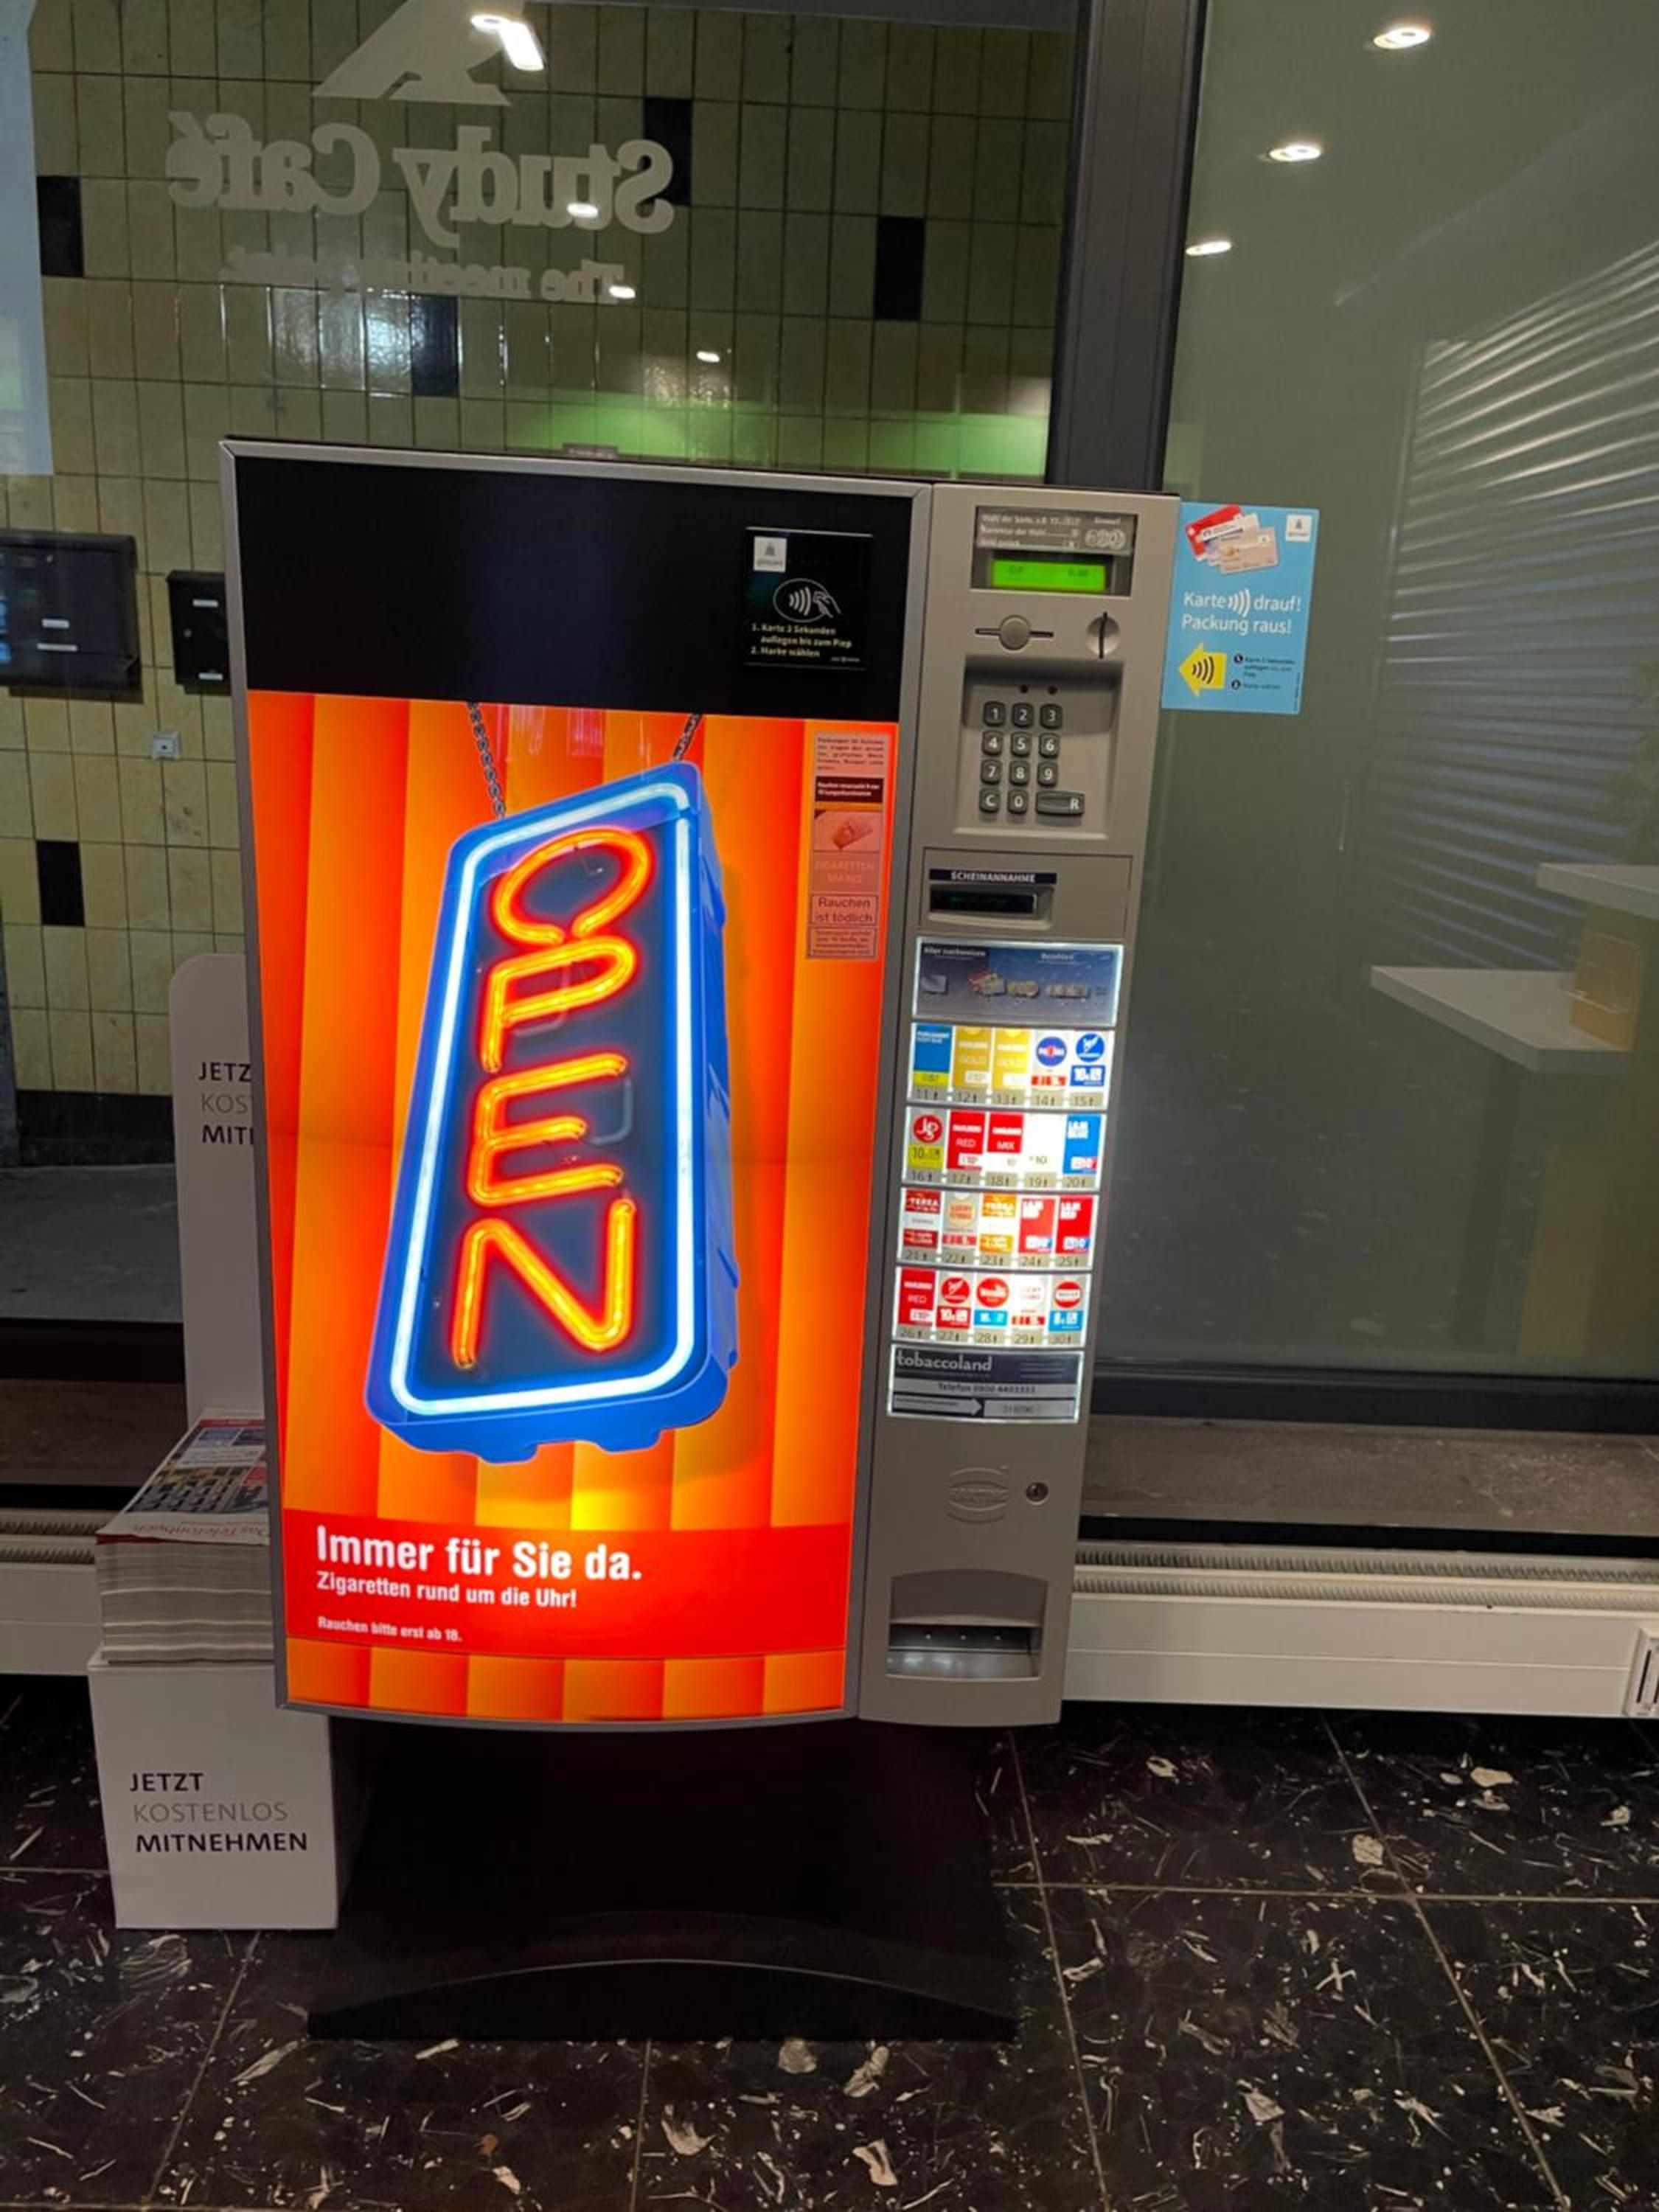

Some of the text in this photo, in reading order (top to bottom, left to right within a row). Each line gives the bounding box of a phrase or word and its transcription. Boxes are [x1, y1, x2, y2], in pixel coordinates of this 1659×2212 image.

[1183, 591, 1301, 612] Karte drauf!
[1182, 613, 1293, 636] Packung raus!
[992, 707, 998, 720] 1
[1019, 709, 1027, 721] 2
[1048, 710, 1056, 722] 3
[989, 737, 997, 748] 4
[1017, 739, 1026, 751] 5
[1046, 740, 1054, 751] 6
[988, 765, 996, 778] 7
[1016, 767, 1024, 779] 8
[1044, 768, 1053, 780] 9
[986, 795, 995, 807] C
[1070, 799, 1079, 810] R
[950, 872, 1036, 883] SCHEINANNAHME
[818, 897, 871, 908] Rauchen
[451, 825, 652, 1371] OPEN
[202, 1124, 254, 1145] MIT
[896, 1350, 992, 1371] tobaccoland
[317, 1525, 641, 1581] Immer für Sie da.
[317, 1571, 576, 1608] Zigaretten rund um die Uhr!
[318, 1615, 462, 1642] Rauchen bitte erst ab 18.
[130, 1773, 204, 1792] JETZT
[133, 1802, 288, 1823] KOSTENLOS
[136, 1832, 307, 1853] MITNEHMEN
